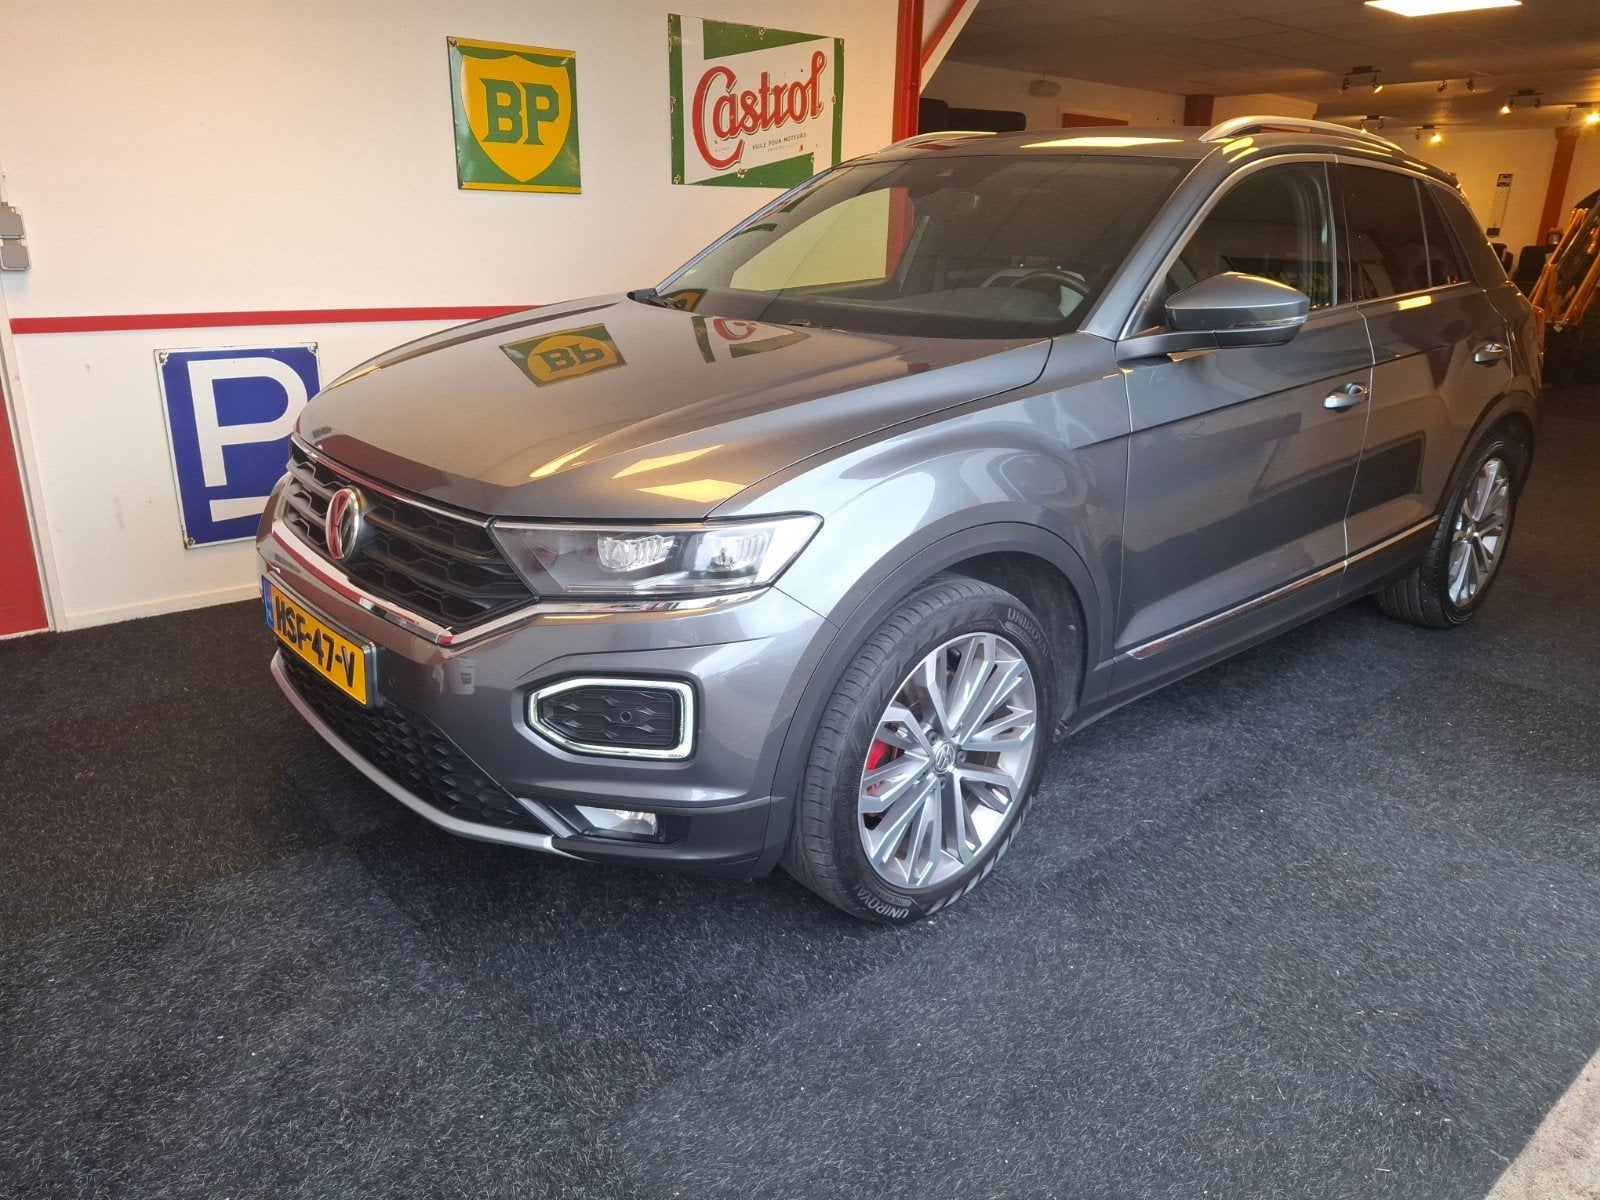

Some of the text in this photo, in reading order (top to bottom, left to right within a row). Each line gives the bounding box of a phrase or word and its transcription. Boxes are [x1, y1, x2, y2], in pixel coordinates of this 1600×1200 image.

[479, 77, 560, 146] BP
[692, 50, 827, 170] Castrol
[768, 138, 782, 147] POUR
[783, 132, 807, 143] MOTEURS
[187, 356, 308, 488] P
[275, 595, 356, 688] HSF-47-V
